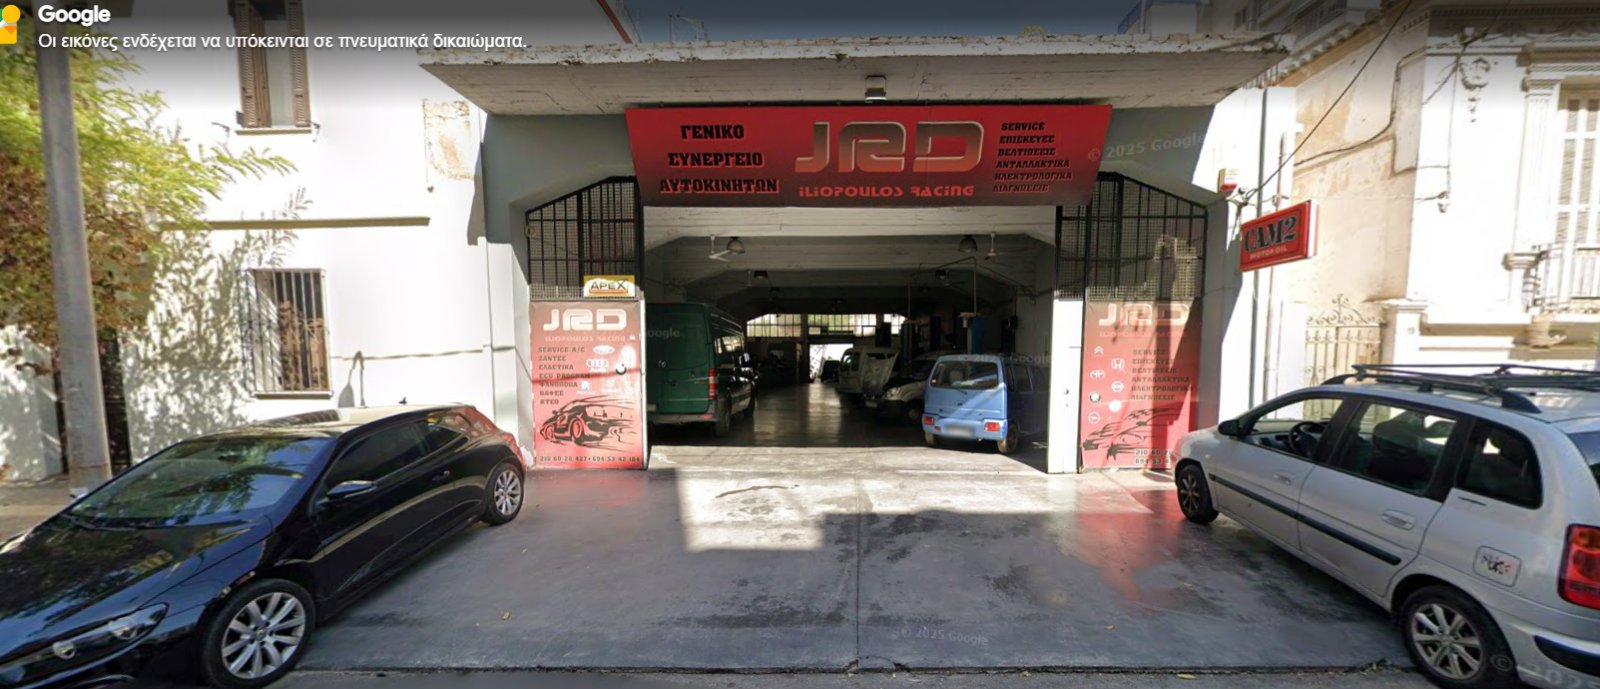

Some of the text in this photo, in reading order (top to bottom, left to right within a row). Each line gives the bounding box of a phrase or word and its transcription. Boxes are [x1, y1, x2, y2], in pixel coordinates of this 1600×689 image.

[680, 124, 745, 139] ΓΕΝΙΚΟ
[1001, 122, 1046, 131] SERVICE
[795, 121, 985, 173] JRD
[668, 152, 764, 168] ΣΥΝΕΡΓΕΙΟ
[996, 160, 1070, 169] ΑΝΤΑΛΛΑΚΤΙΚΑ
[659, 178, 780, 194] ΑΥΤΟΚΙΝΗΤΩΝ
[1244, 216, 1298, 252] CAM2
[590, 280, 627, 290] APEX
[543, 308, 627, 331] JRD
